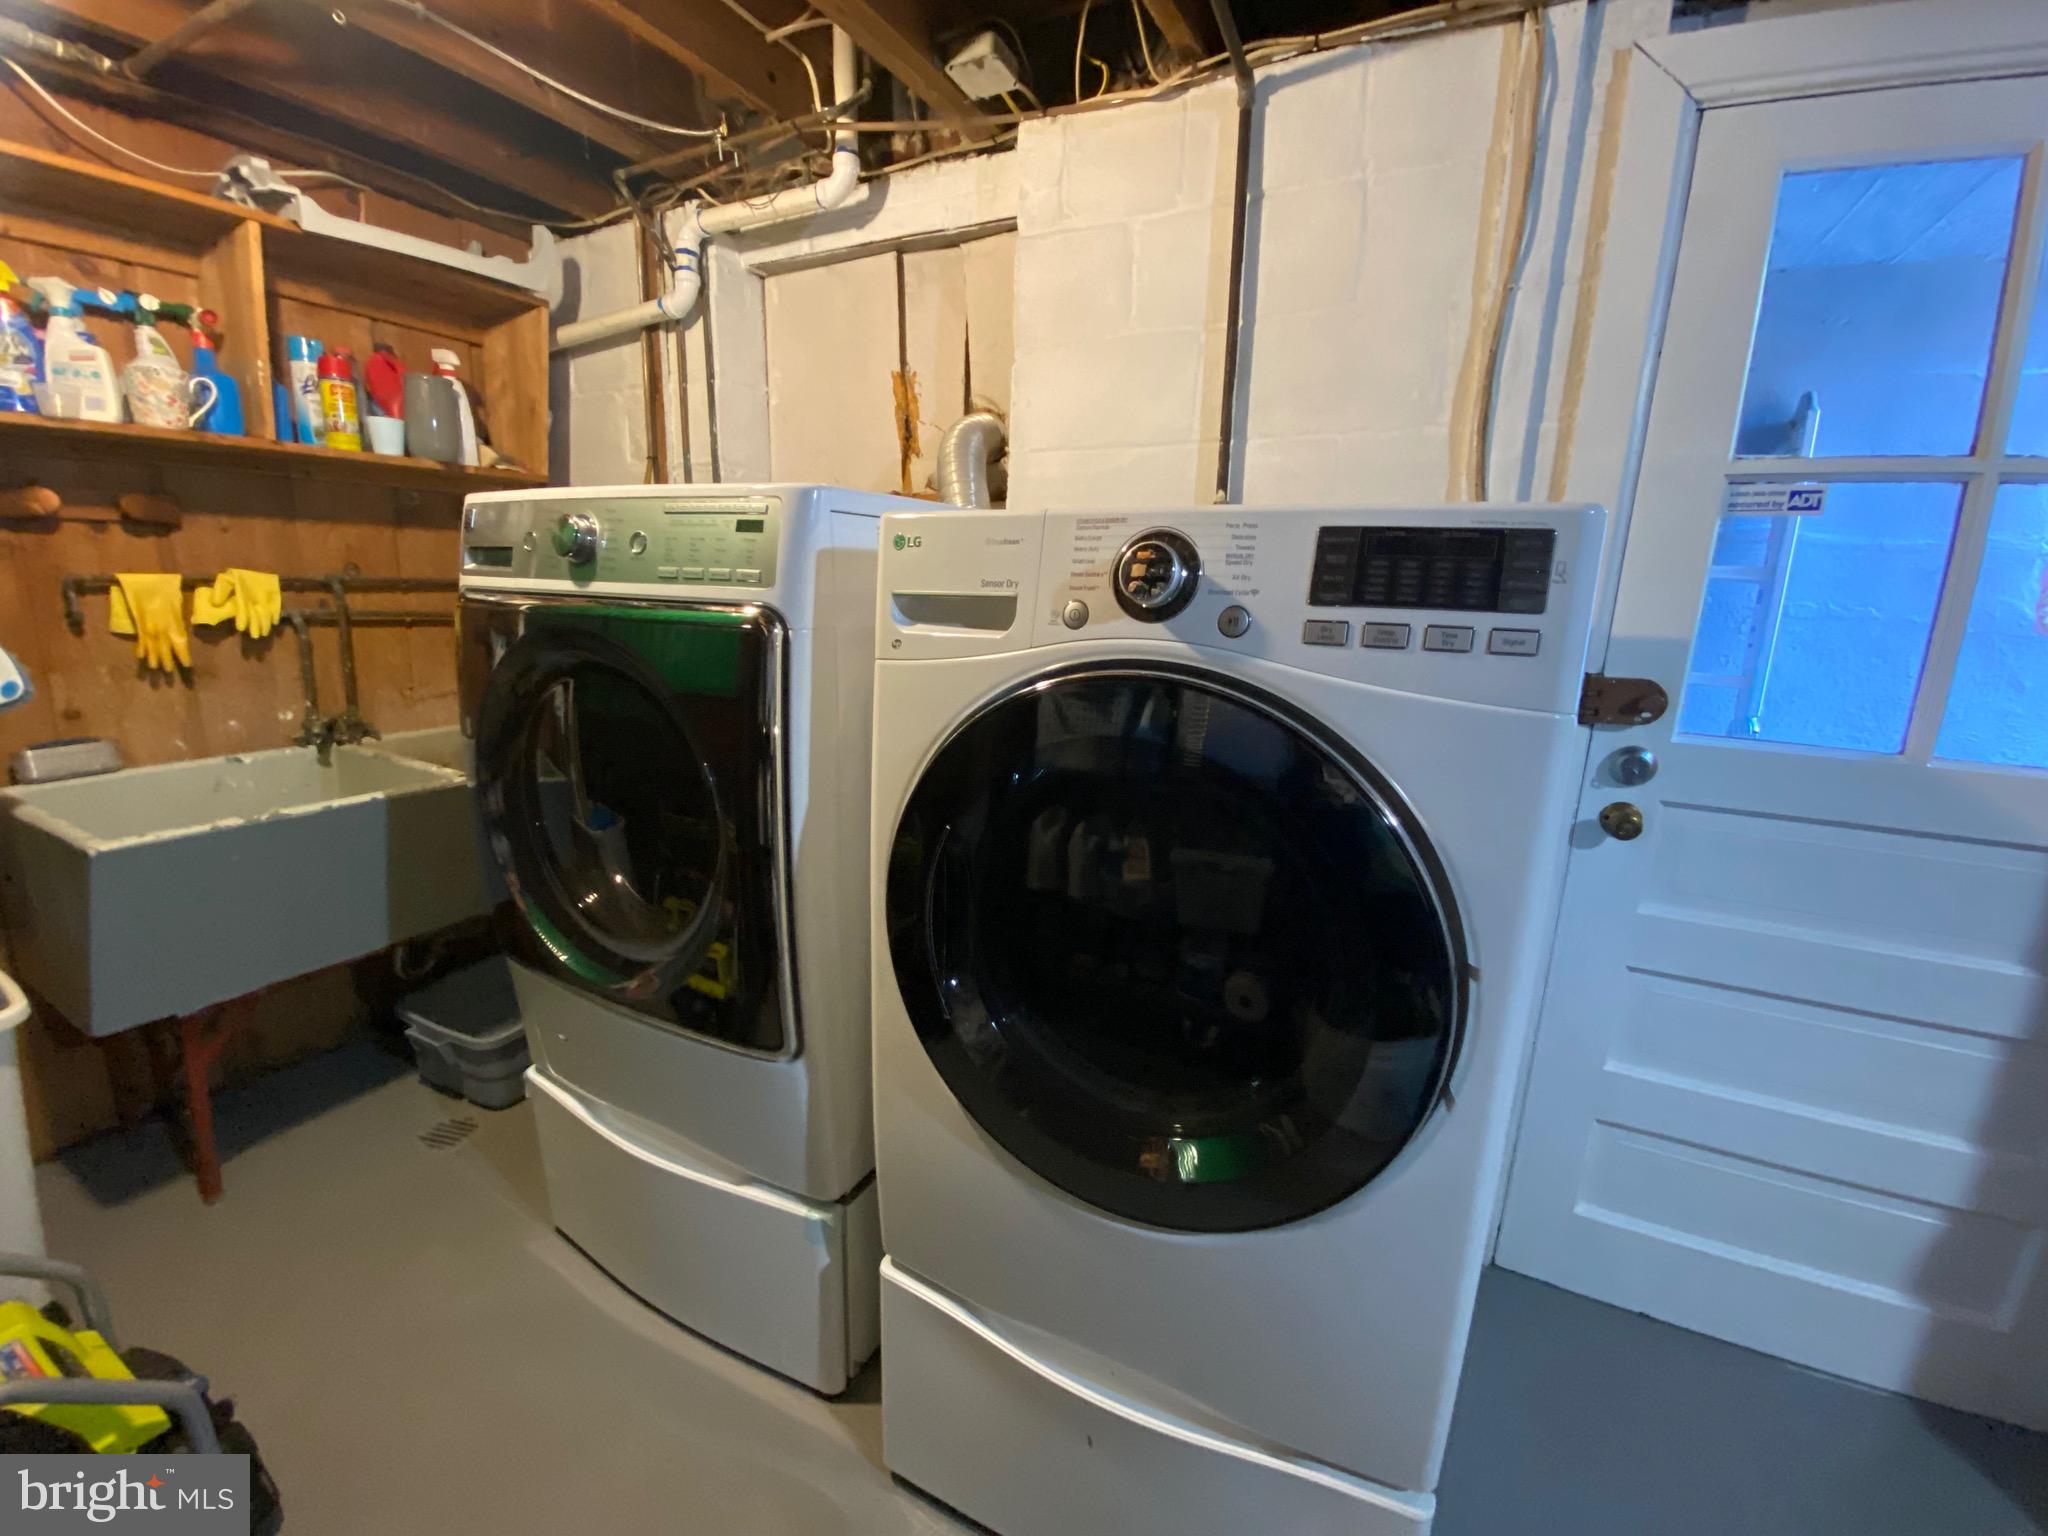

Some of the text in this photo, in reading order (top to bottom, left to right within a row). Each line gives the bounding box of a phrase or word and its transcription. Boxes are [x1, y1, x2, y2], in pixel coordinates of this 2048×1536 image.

[1788, 492, 1823, 508] ADT
[906, 536, 922, 548] LG
[980, 578, 1020, 590] Sensor Dry
